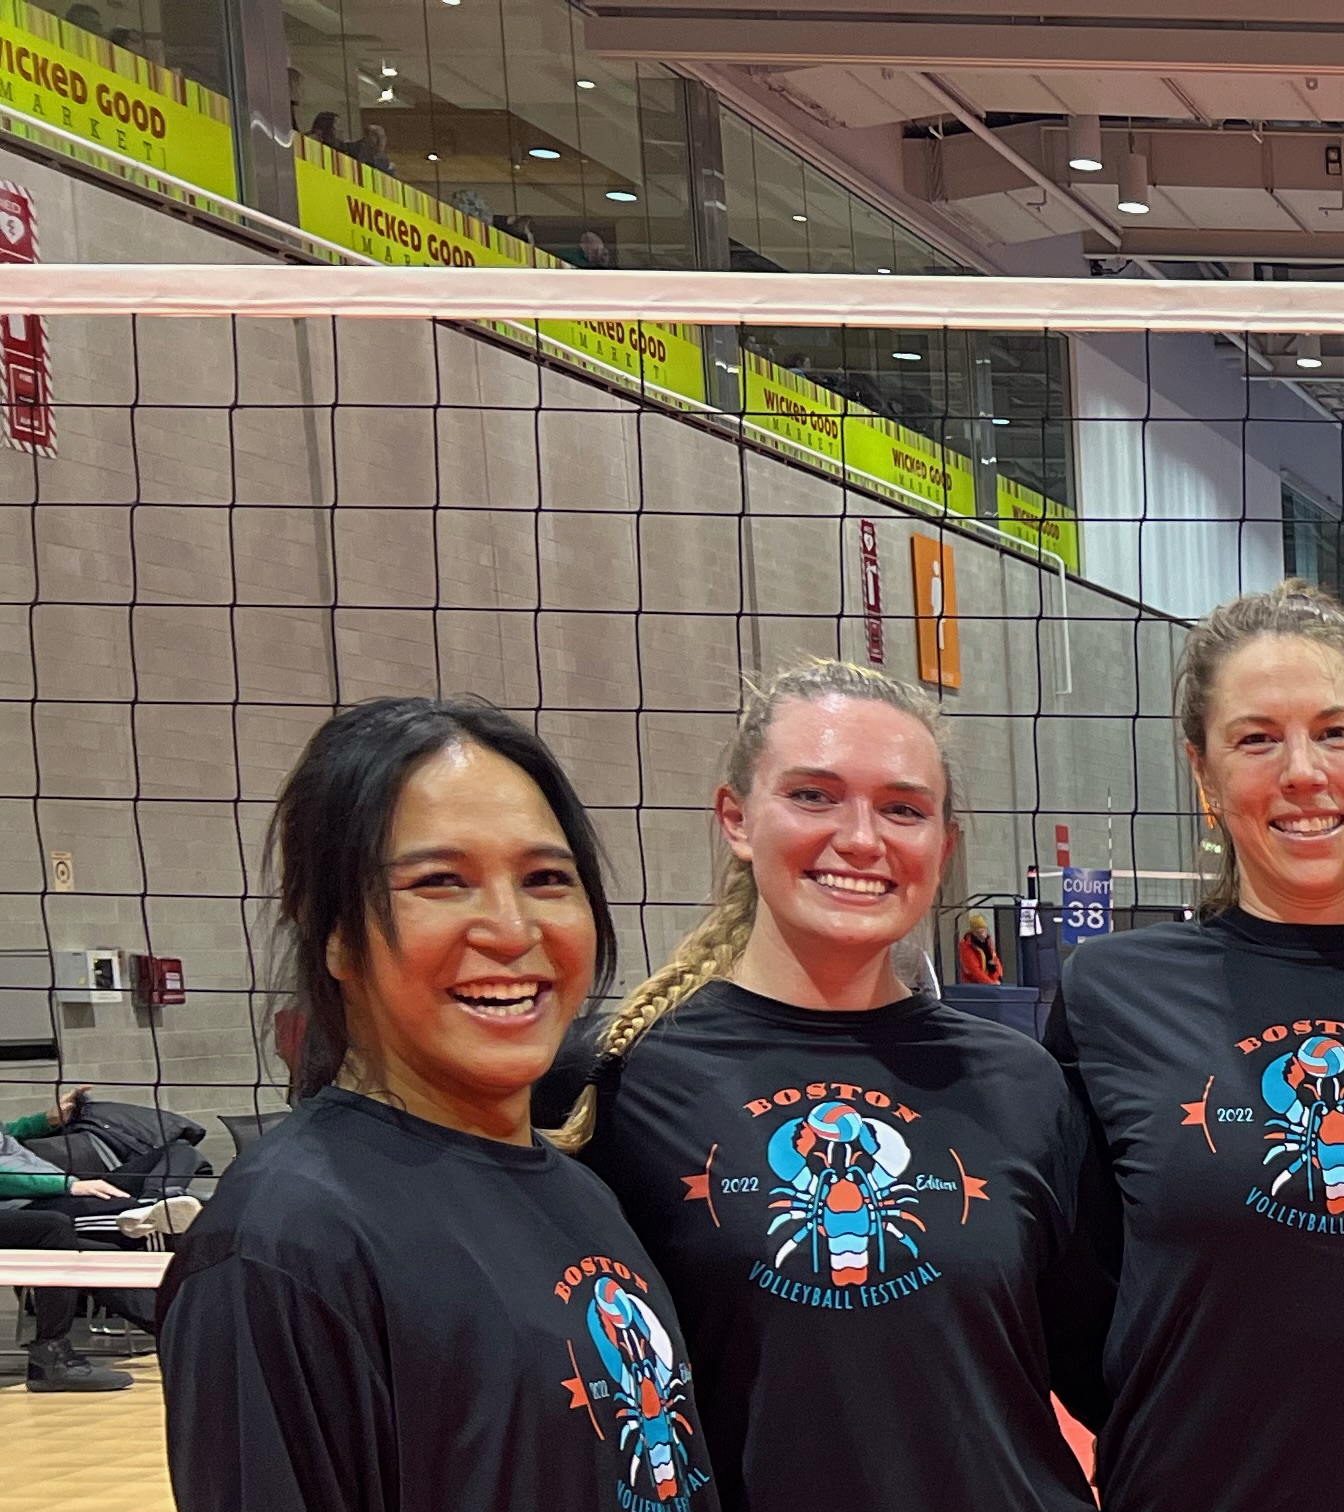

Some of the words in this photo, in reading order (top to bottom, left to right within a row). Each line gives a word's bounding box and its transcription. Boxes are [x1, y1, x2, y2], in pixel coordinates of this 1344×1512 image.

[96, 83, 167, 140] GOOD
[427, 234, 476, 267] GOOD
[629, 327, 667, 363] GOOD
[810, 414, 839, 440] GOOD
[1063, 878, 1110, 895] COURT
[1067, 900, 1105, 929] 38
[743, 1081, 922, 1124] BOSTON
[1217, 1107, 1255, 1123] 2022
[721, 1176, 760, 1194] 2022
[553, 1255, 649, 1304] BOSTON
[749, 1260, 854, 1310] VOLLEYBALL
[860, 1262, 943, 1308] FESTIVAL
